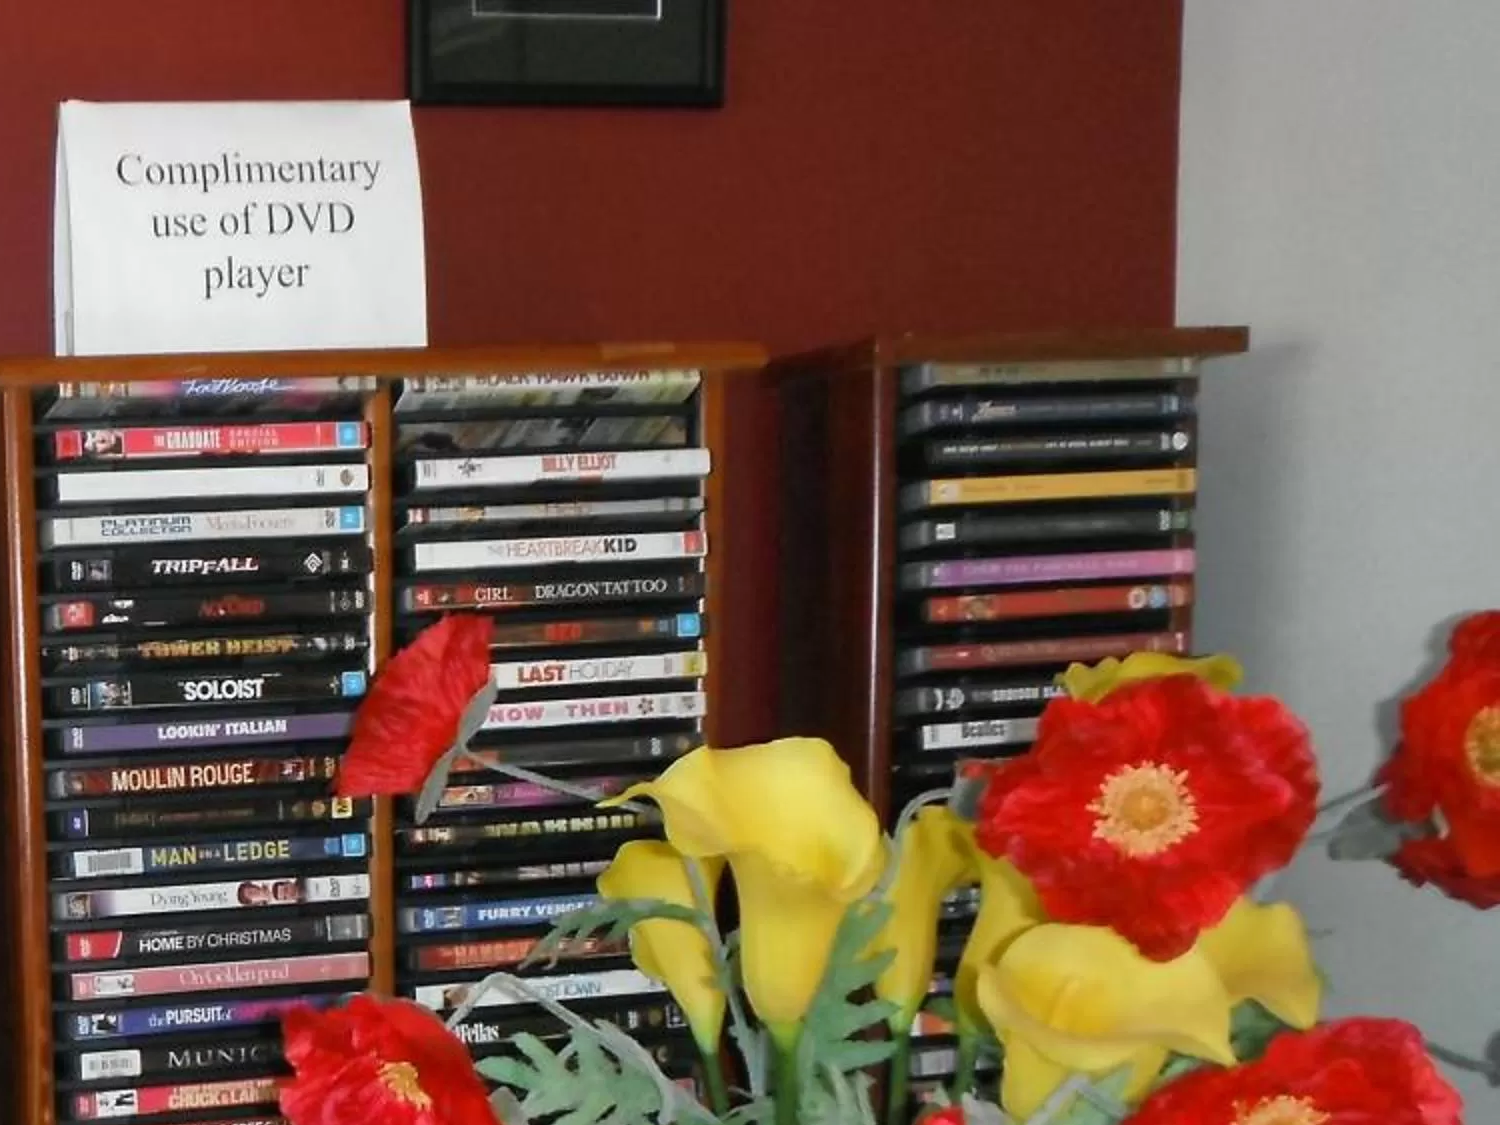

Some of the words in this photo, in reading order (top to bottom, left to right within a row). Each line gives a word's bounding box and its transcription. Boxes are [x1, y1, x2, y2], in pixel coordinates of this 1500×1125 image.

[116, 152, 381, 192] Complimentary
[152, 211, 207, 237] use
[219, 202, 257, 236] of
[267, 201, 355, 235] DVD
[203, 255, 310, 299] player
[603, 537, 637, 553] KID
[152, 557, 259, 576] TRIPFALL
[475, 586, 513, 601] GIRL
[535, 581, 599, 600] DRAGON
[601, 578, 667, 596] TATTOO
[517, 663, 566, 684] LAST
[183, 678, 264, 701] SOLOIST
[489, 705, 545, 724] NOW
[566, 701, 630, 719] THEN
[225, 719, 288, 736] ITALIAN
[112, 765, 186, 791] MOULIN
[192, 763, 254, 787] ROUGE
[151, 846, 197, 867] MAN
[223, 840, 290, 862] LEDGE
[477, 904, 531, 922] FURRY
[139, 936, 184, 953] HOME
[186, 934, 207, 949] BY
[207, 928, 292, 947] CHRISTMAS
[165, 1007, 222, 1026] PURSUIT
[167, 1046, 272, 1069] MUNIC
